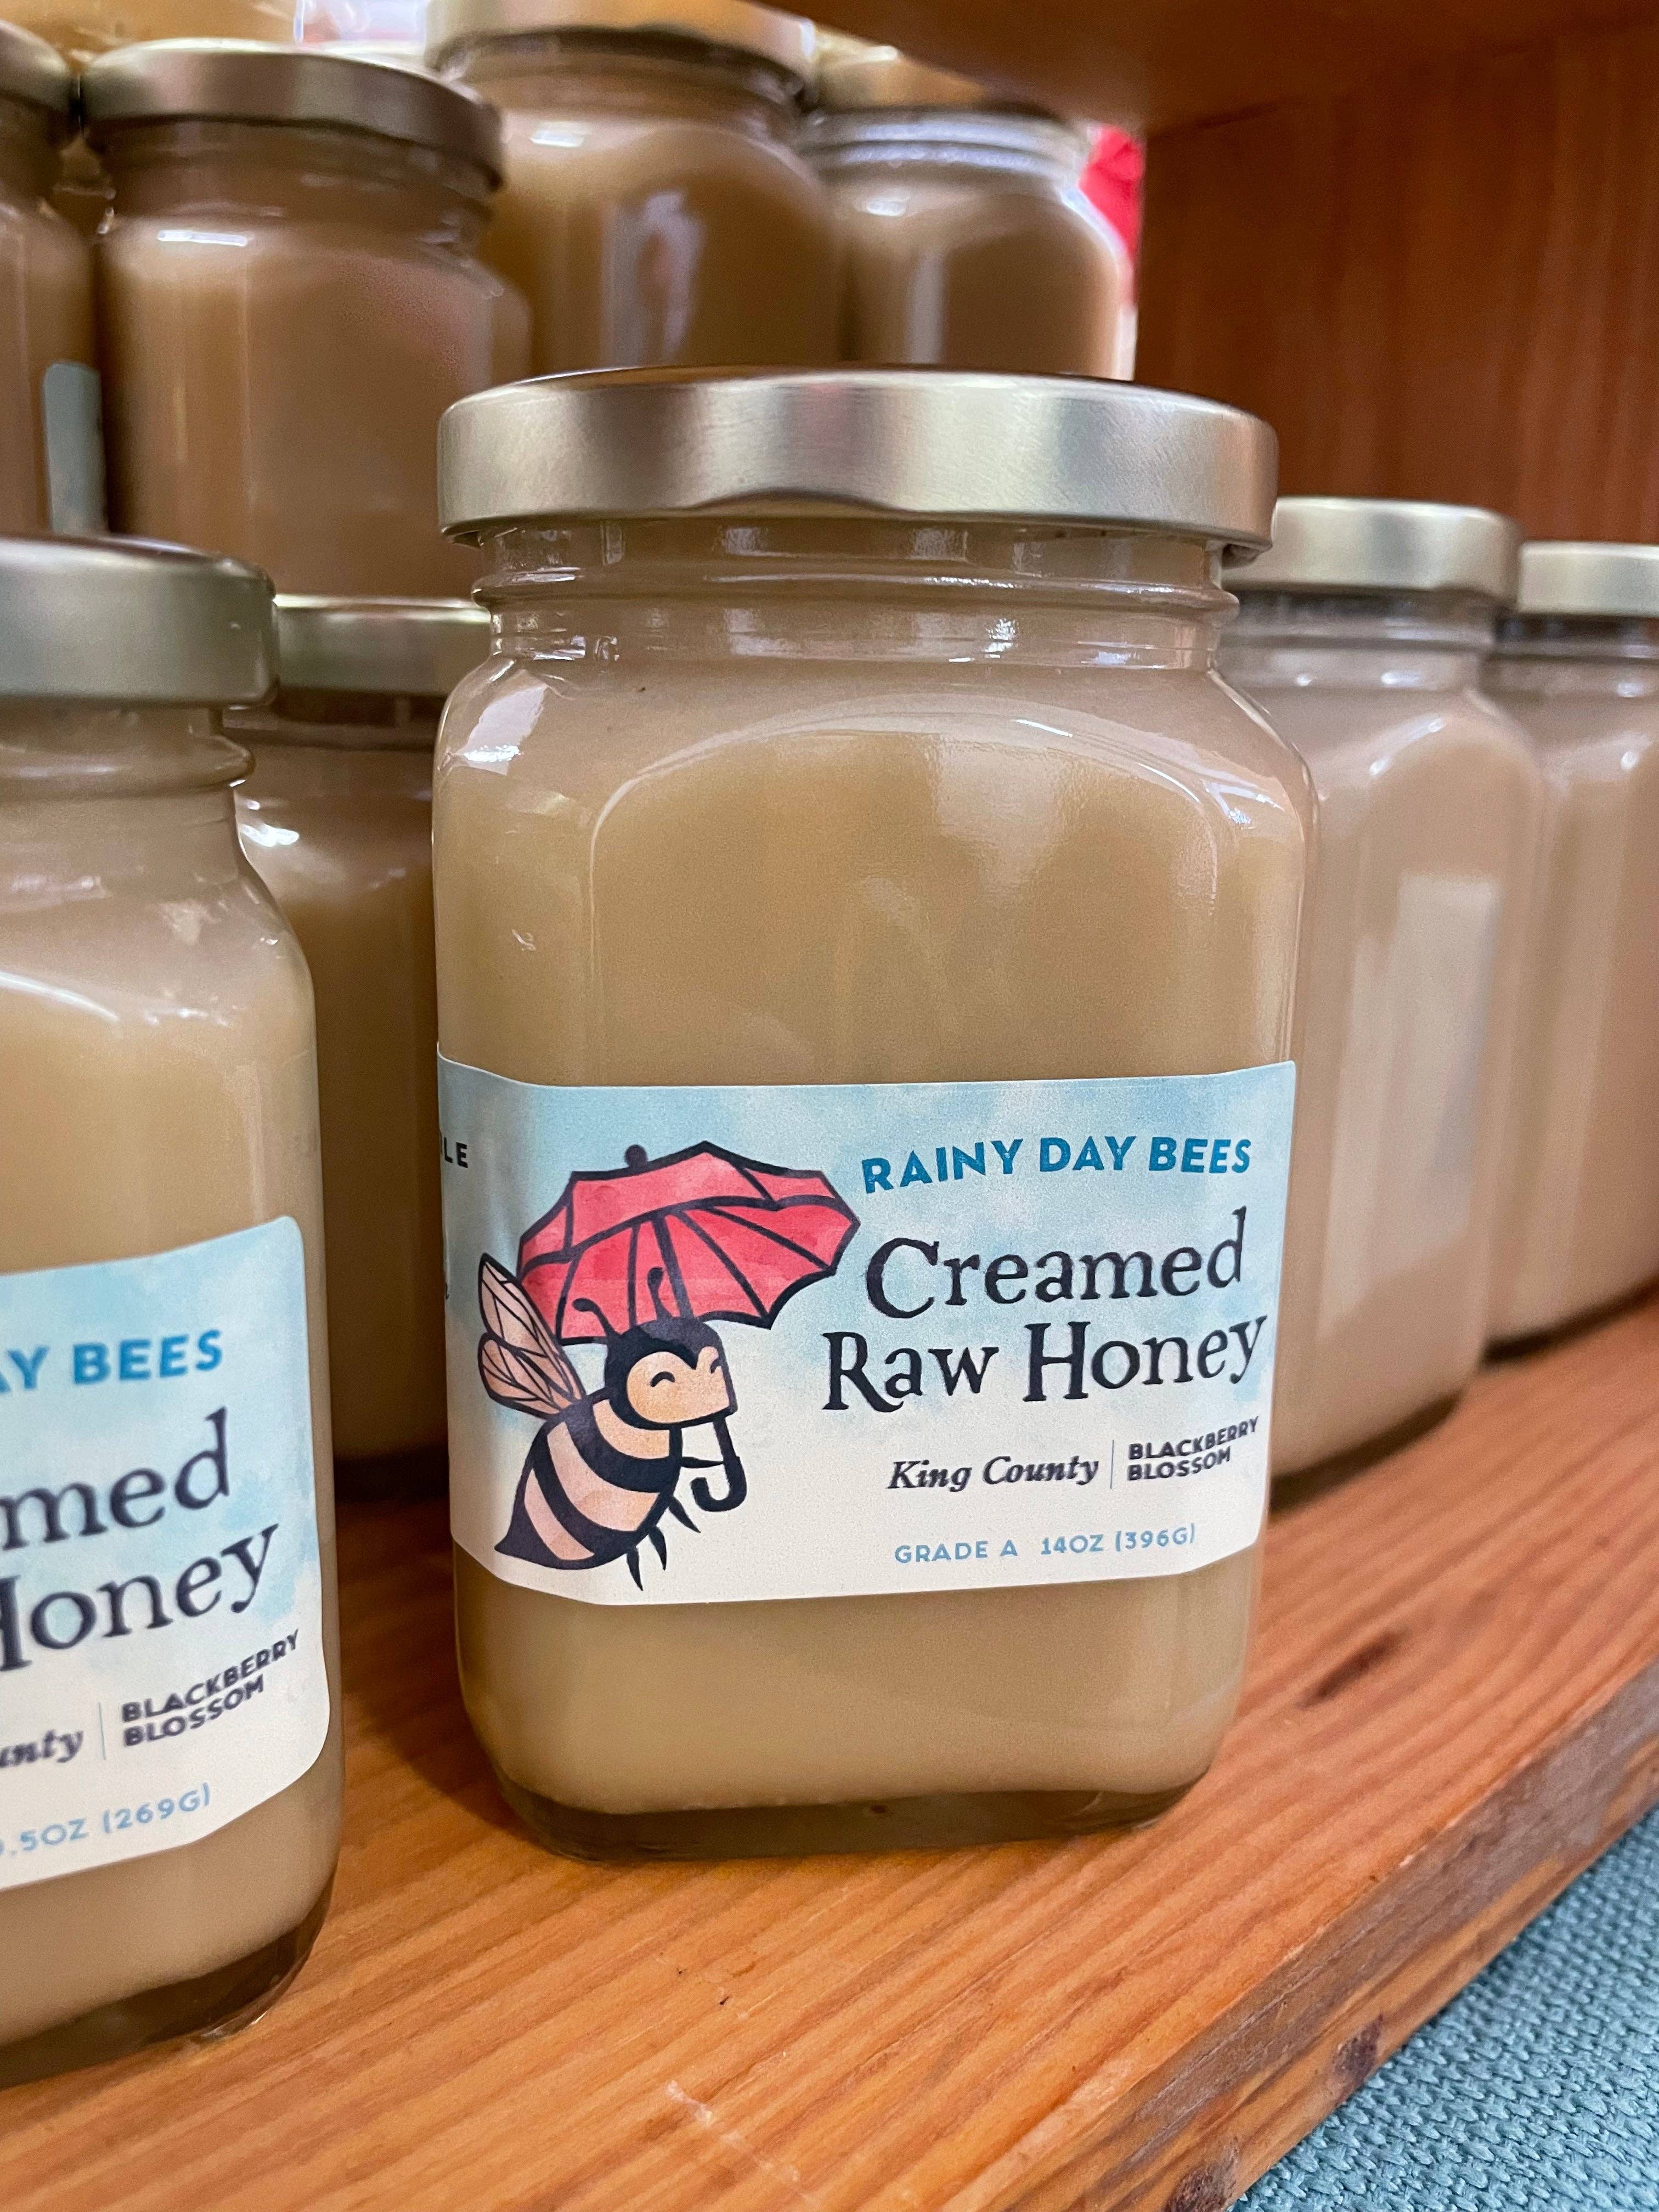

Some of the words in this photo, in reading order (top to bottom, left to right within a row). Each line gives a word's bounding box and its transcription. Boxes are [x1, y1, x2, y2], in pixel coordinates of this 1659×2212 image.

[441, 1132, 469, 1169] LE
[862, 1139, 1023, 1193] RAINY
[1040, 1136, 1136, 1172] DAY
[1149, 1138, 1252, 1174] BEES
[866, 1206, 1247, 1319] Creamed
[0, 1345, 50, 1394] Y
[73, 1329, 223, 1385] BEES
[822, 1333, 999, 1413] Raw
[1024, 1315, 1268, 1403] Honey
[1128, 1417, 1259, 1461] BLACKBERRY
[1128, 1447, 1231, 1482] BLOSSOM
[887, 1460, 972, 1492] King
[983, 1457, 1099, 1487] County
[895, 1540, 988, 1564] GRADE
[1000, 1540, 1018, 1558] A
[1041, 1533, 1104, 1555] 14OZ
[1115, 1524, 1196, 1554] (396G)
[121, 1629, 299, 1722] BLACKBERRY
[123, 1674, 264, 1747] BLOSSOM
[0, 1818, 89, 1856] .5OZ
[103, 1782, 211, 1834] (269G)
